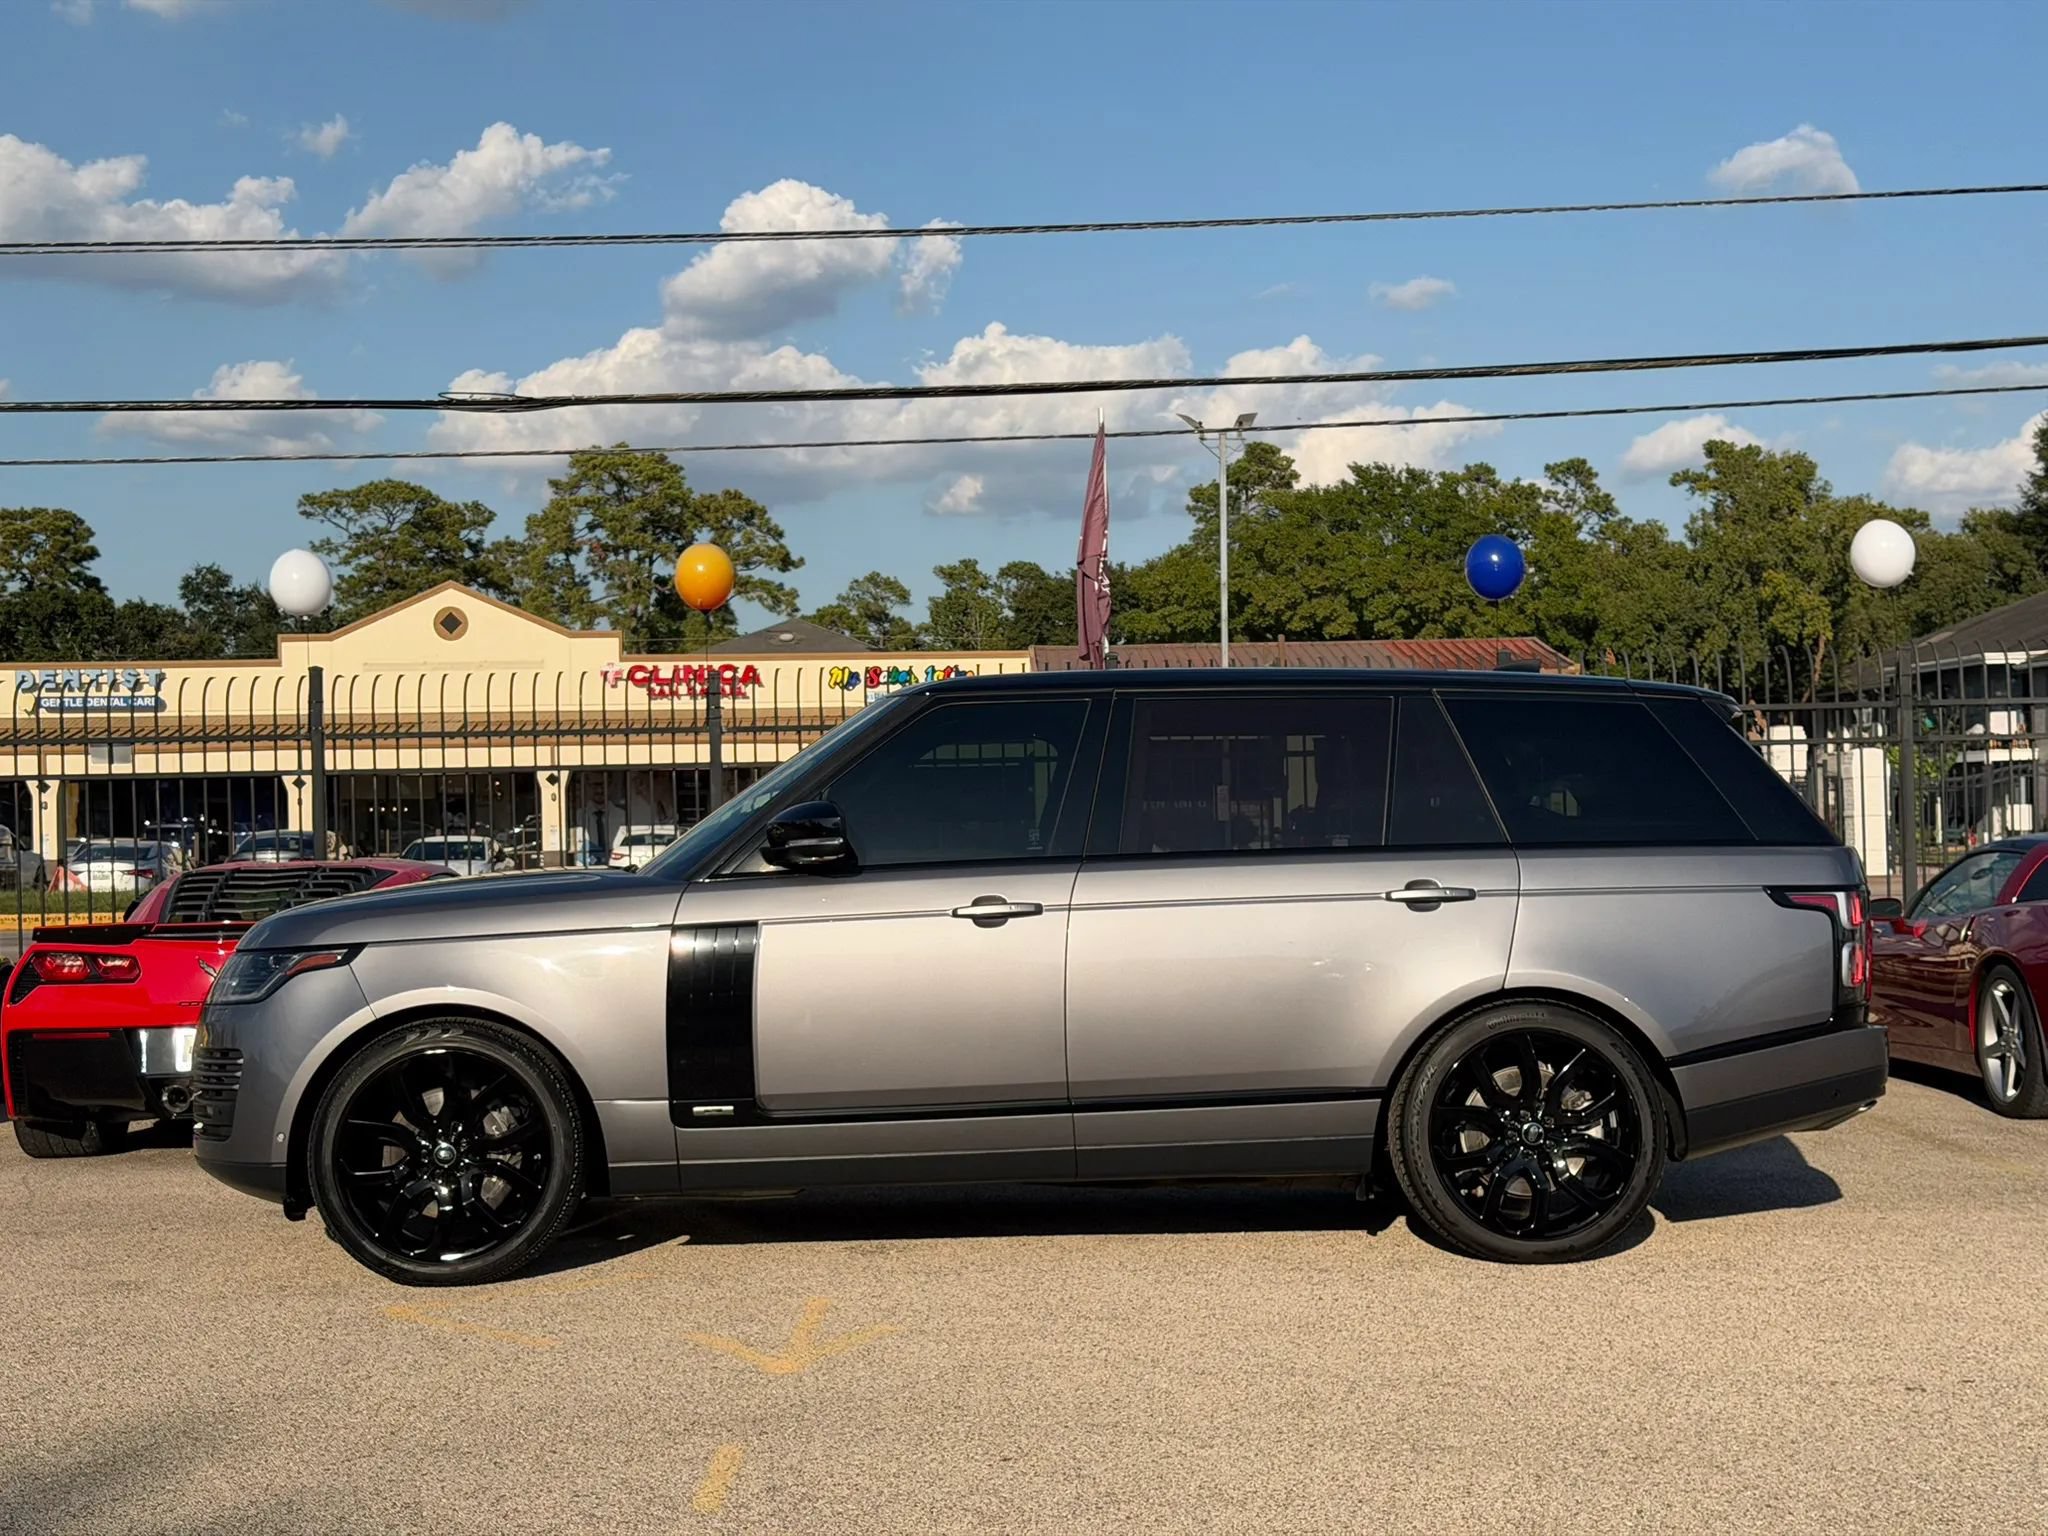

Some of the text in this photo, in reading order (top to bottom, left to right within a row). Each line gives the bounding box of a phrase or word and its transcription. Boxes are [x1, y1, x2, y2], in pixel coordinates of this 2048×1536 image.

[15, 669, 163, 690] DENTIST
[41, 697, 83, 707] GENTLE
[87, 697, 127, 707] DENTAL
